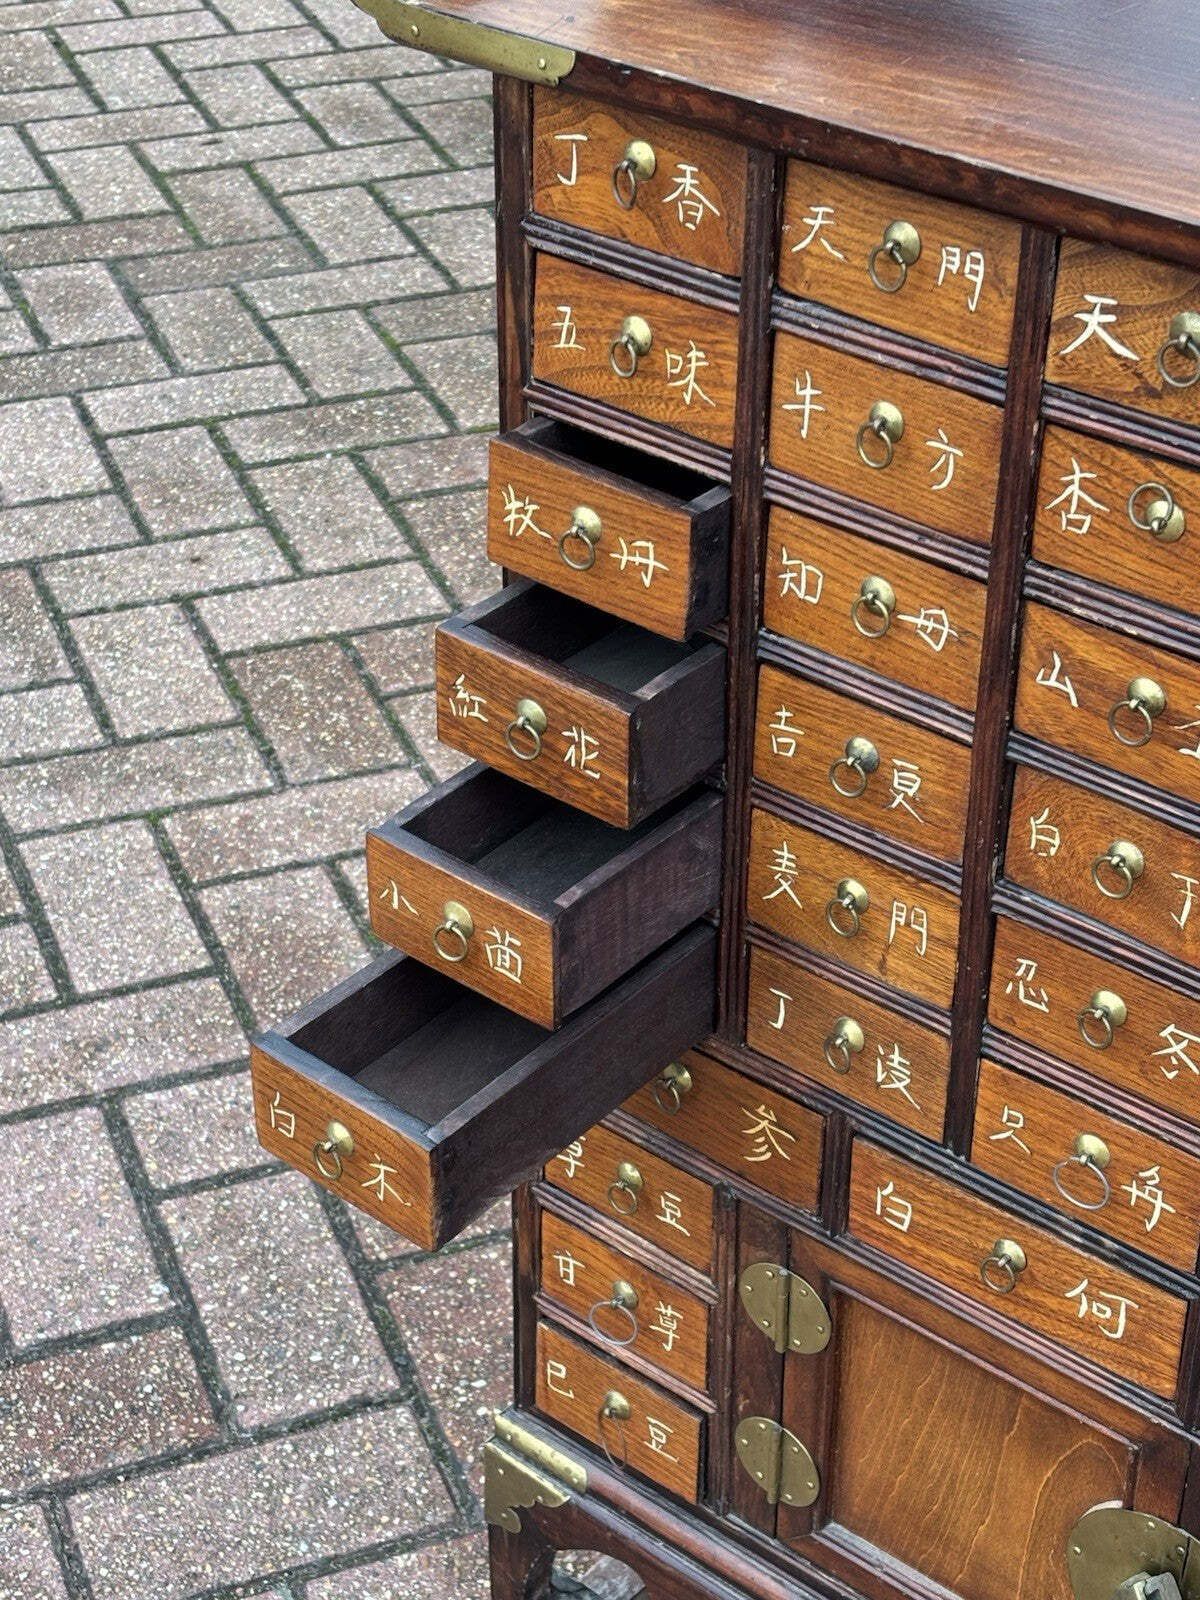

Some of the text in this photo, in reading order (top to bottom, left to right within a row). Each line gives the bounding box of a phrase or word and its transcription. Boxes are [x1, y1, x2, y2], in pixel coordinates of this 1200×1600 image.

[554, 133, 720, 231] 丁香
[551, 306, 716, 407] 五味
[1059, 294, 1140, 361] 天
